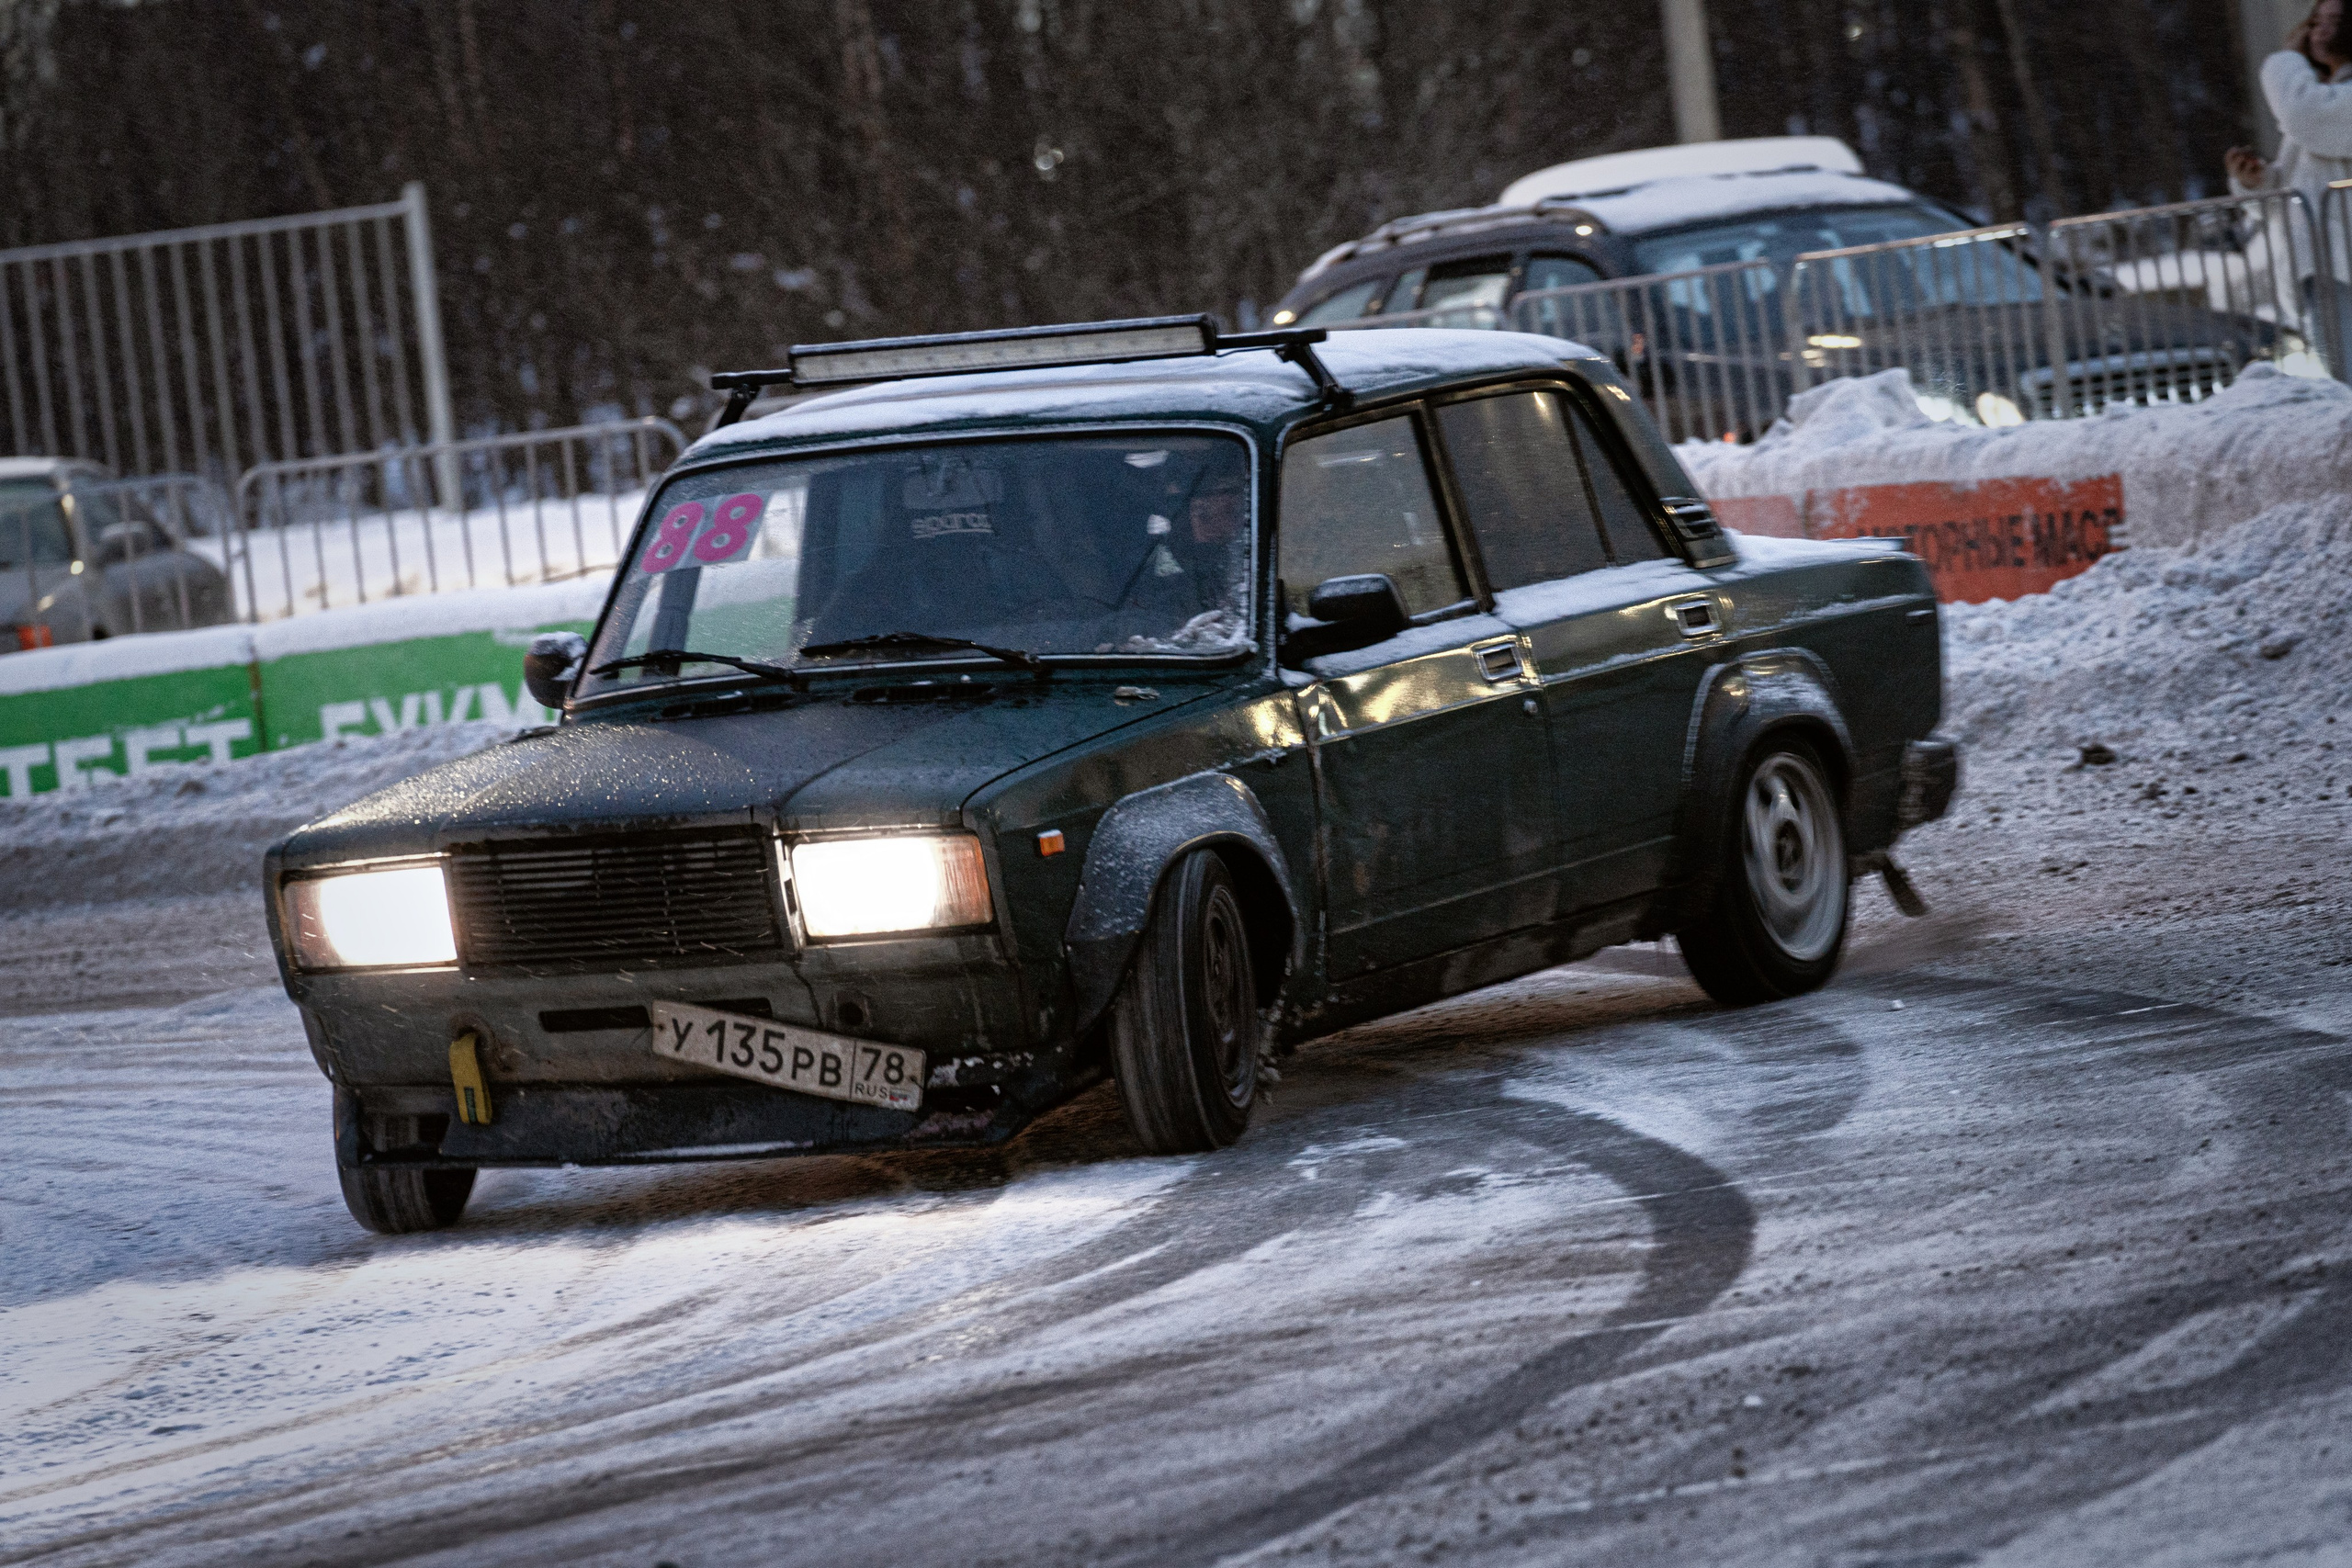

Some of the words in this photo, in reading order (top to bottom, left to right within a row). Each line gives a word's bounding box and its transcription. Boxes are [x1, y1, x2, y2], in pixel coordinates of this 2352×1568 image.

[641, 493, 763, 573] 88
[862, 1046, 906, 1086] 78
[854, 1081, 888, 1100] RUS
